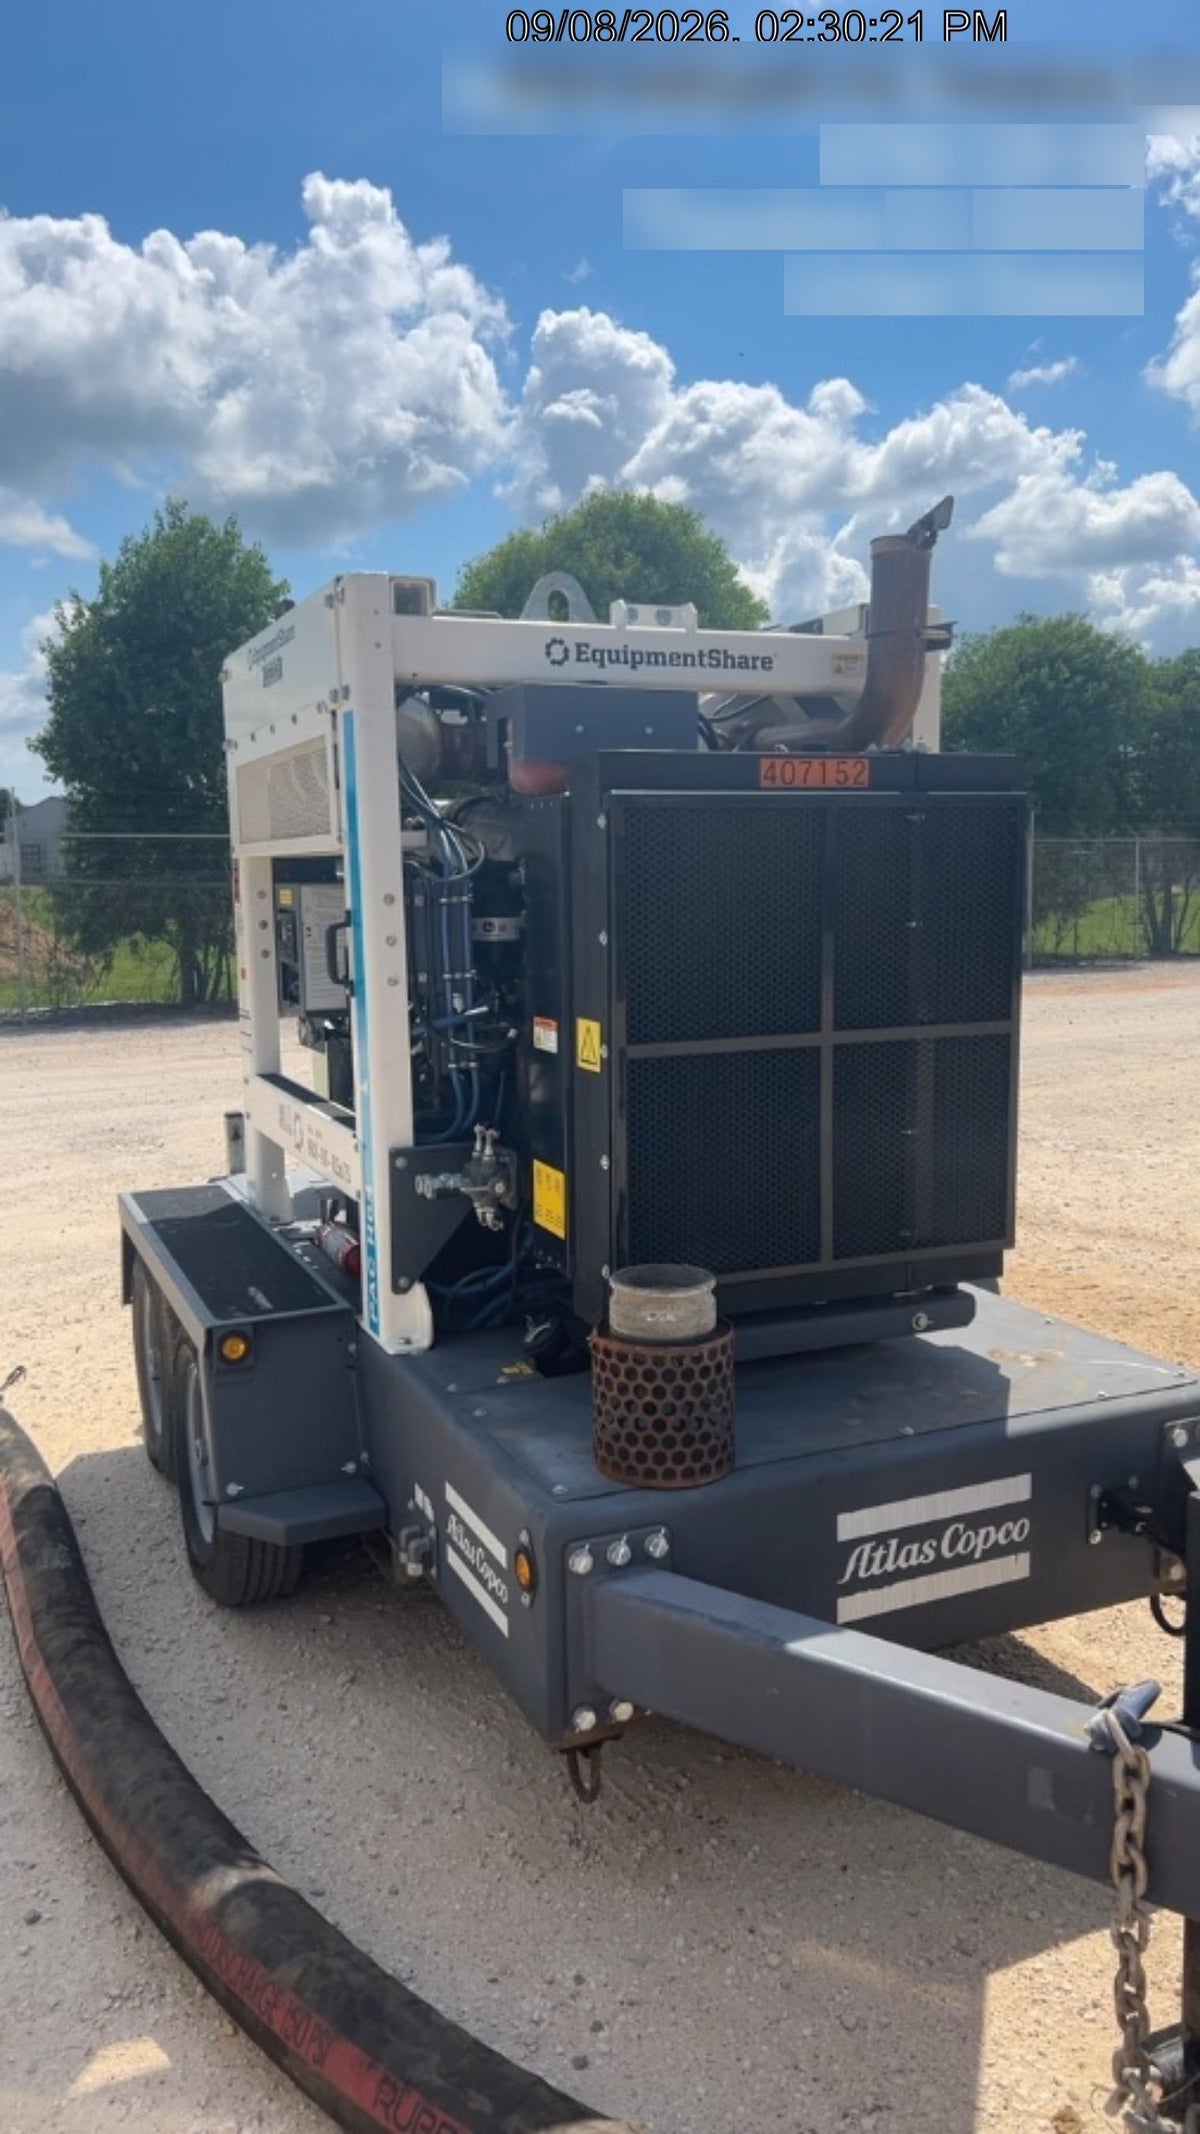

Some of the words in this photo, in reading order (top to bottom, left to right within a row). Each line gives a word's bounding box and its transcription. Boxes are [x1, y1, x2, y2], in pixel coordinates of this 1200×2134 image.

[575, 642, 774, 671] EquipmentShare
[763, 760, 867, 786] 407152
[837, 1538, 937, 1585] Atlas
[940, 1517, 1030, 1559] Copco
